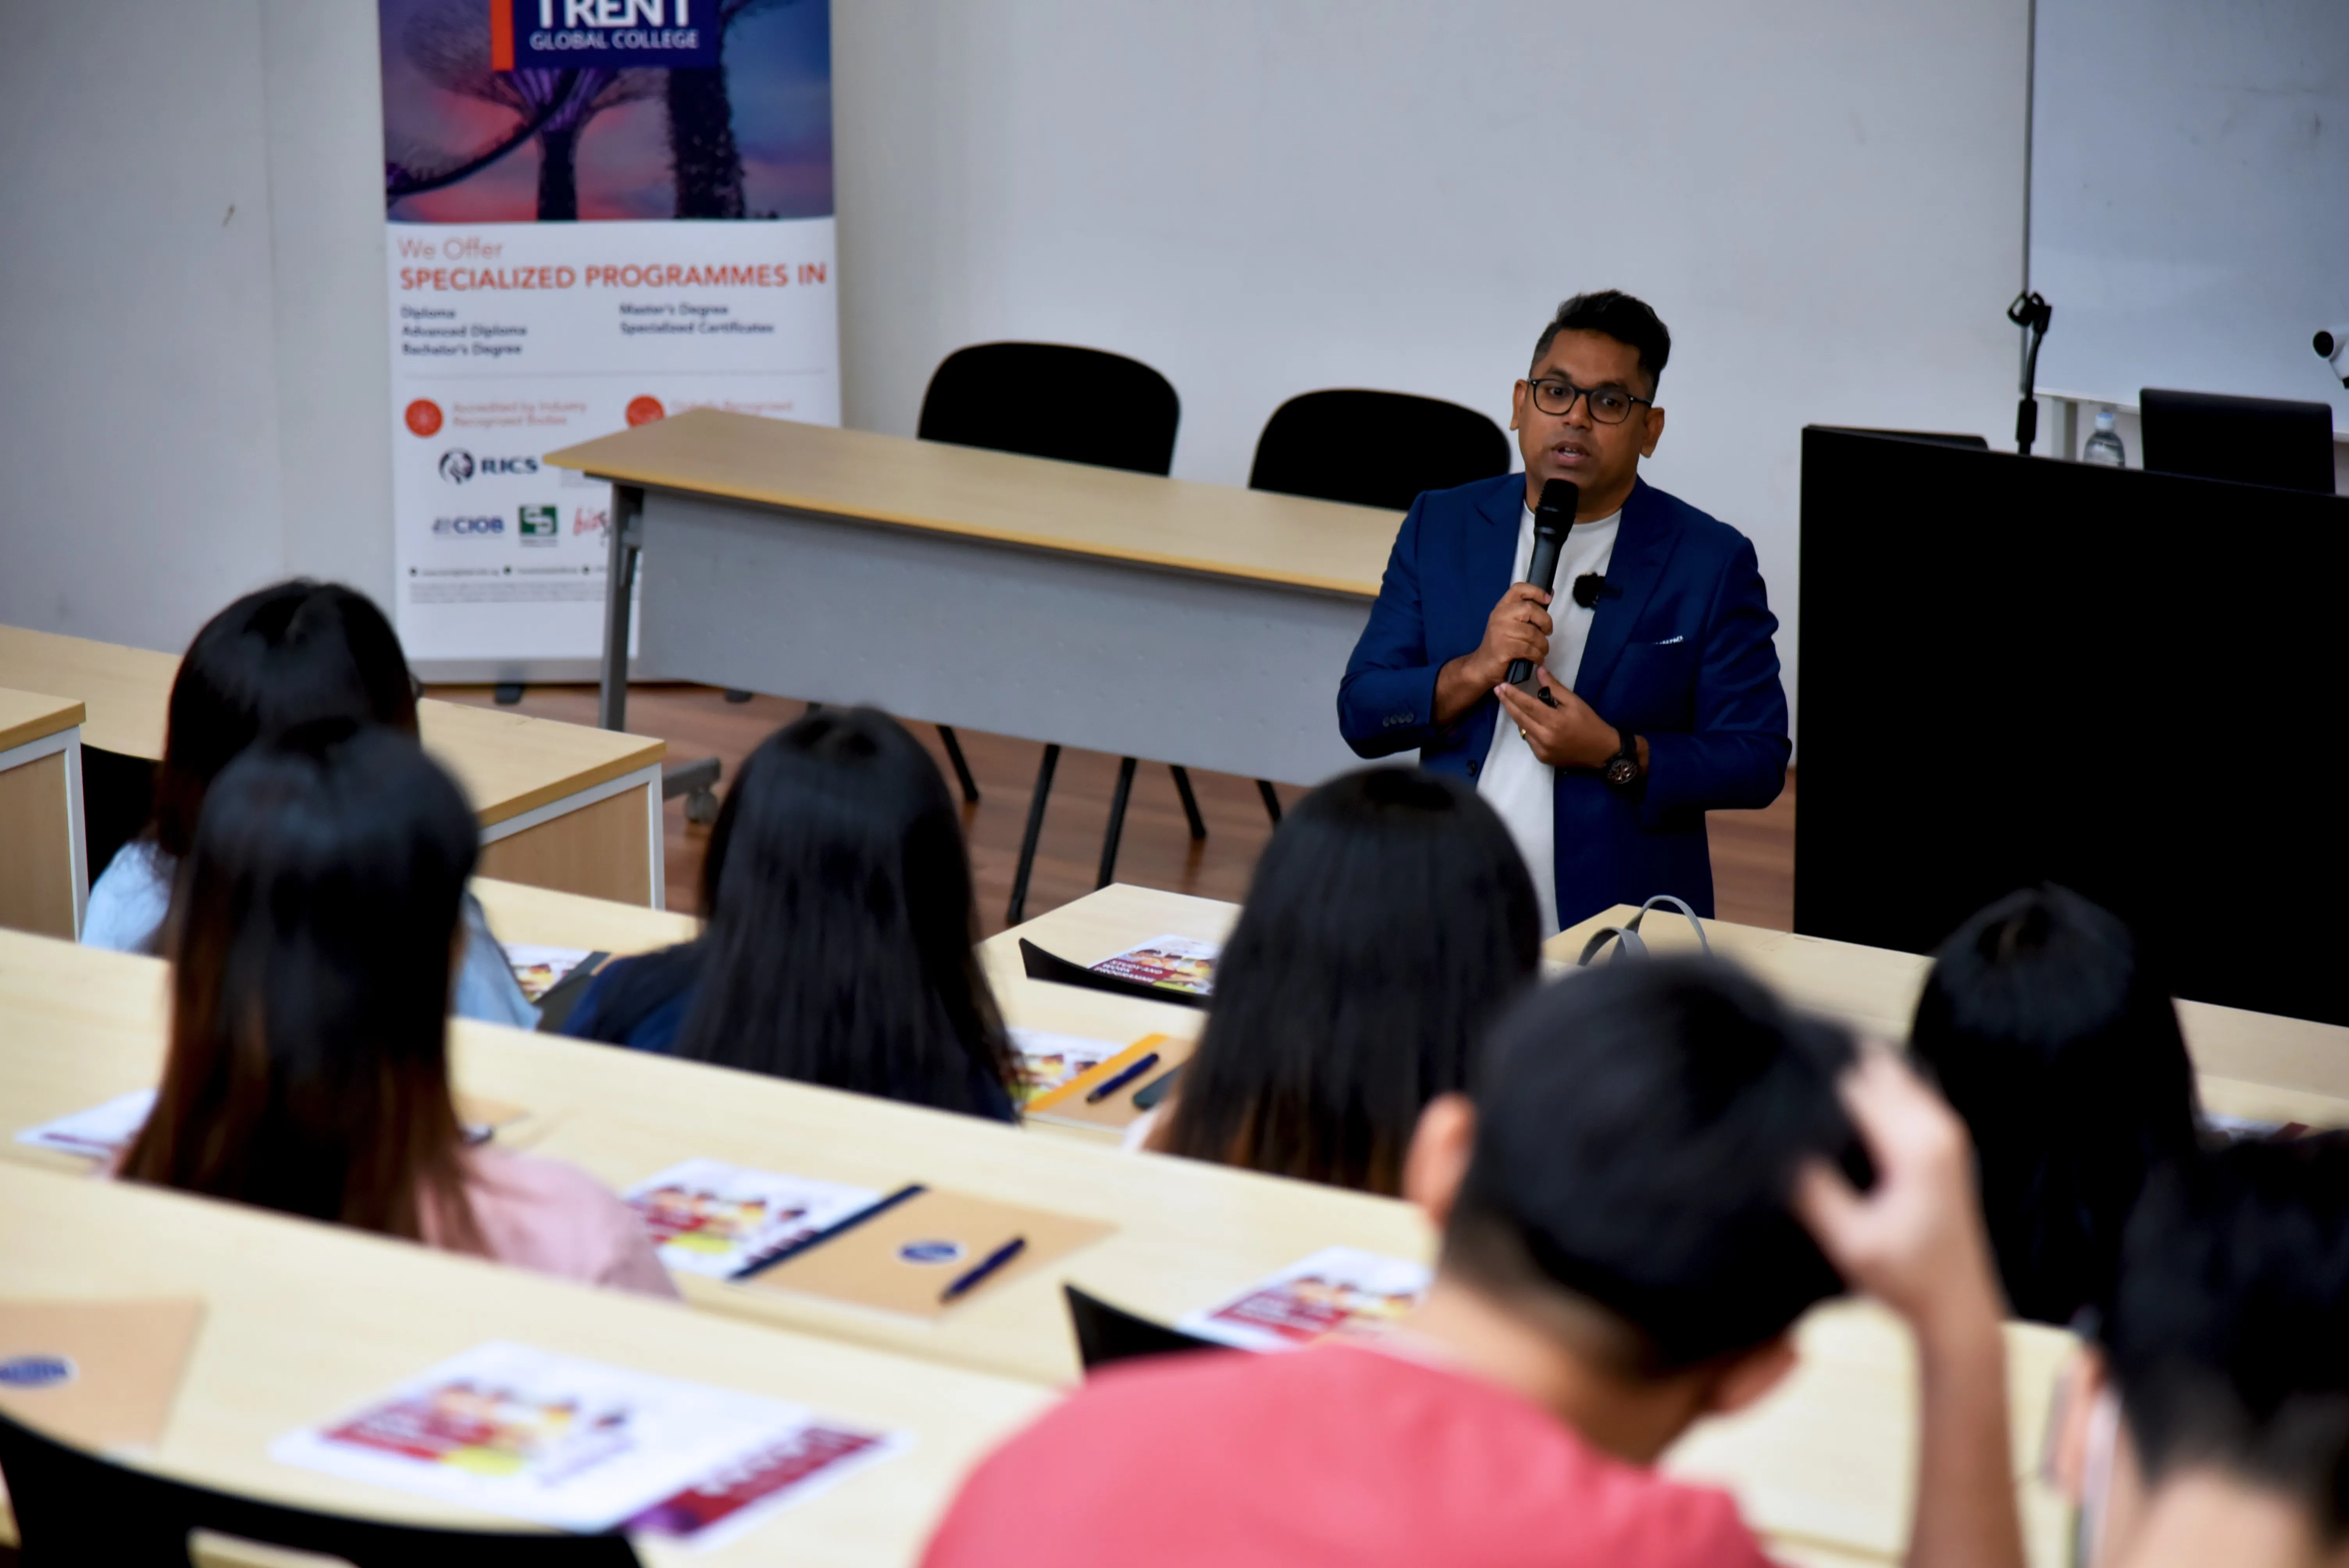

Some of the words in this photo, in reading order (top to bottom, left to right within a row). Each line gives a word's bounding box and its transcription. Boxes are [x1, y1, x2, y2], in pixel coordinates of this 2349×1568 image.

[529, 30, 609, 50] GLOBAL
[611, 29, 700, 49] COLLEGE
[398, 237, 435, 259] We
[442, 235, 503, 260] Offer
[400, 267, 576, 291] SPECIALIZED
[586, 264, 789, 287] PROGRAMMES
[798, 263, 827, 284] IN
[401, 305, 456, 320] Diploma
[679, 302, 730, 318] Degree
[403, 324, 467, 336] Advanced
[471, 323, 528, 339] Diploma
[698, 320, 775, 334] Certificates
[472, 342, 523, 358] Degree
[480, 457, 539, 474] RICS
